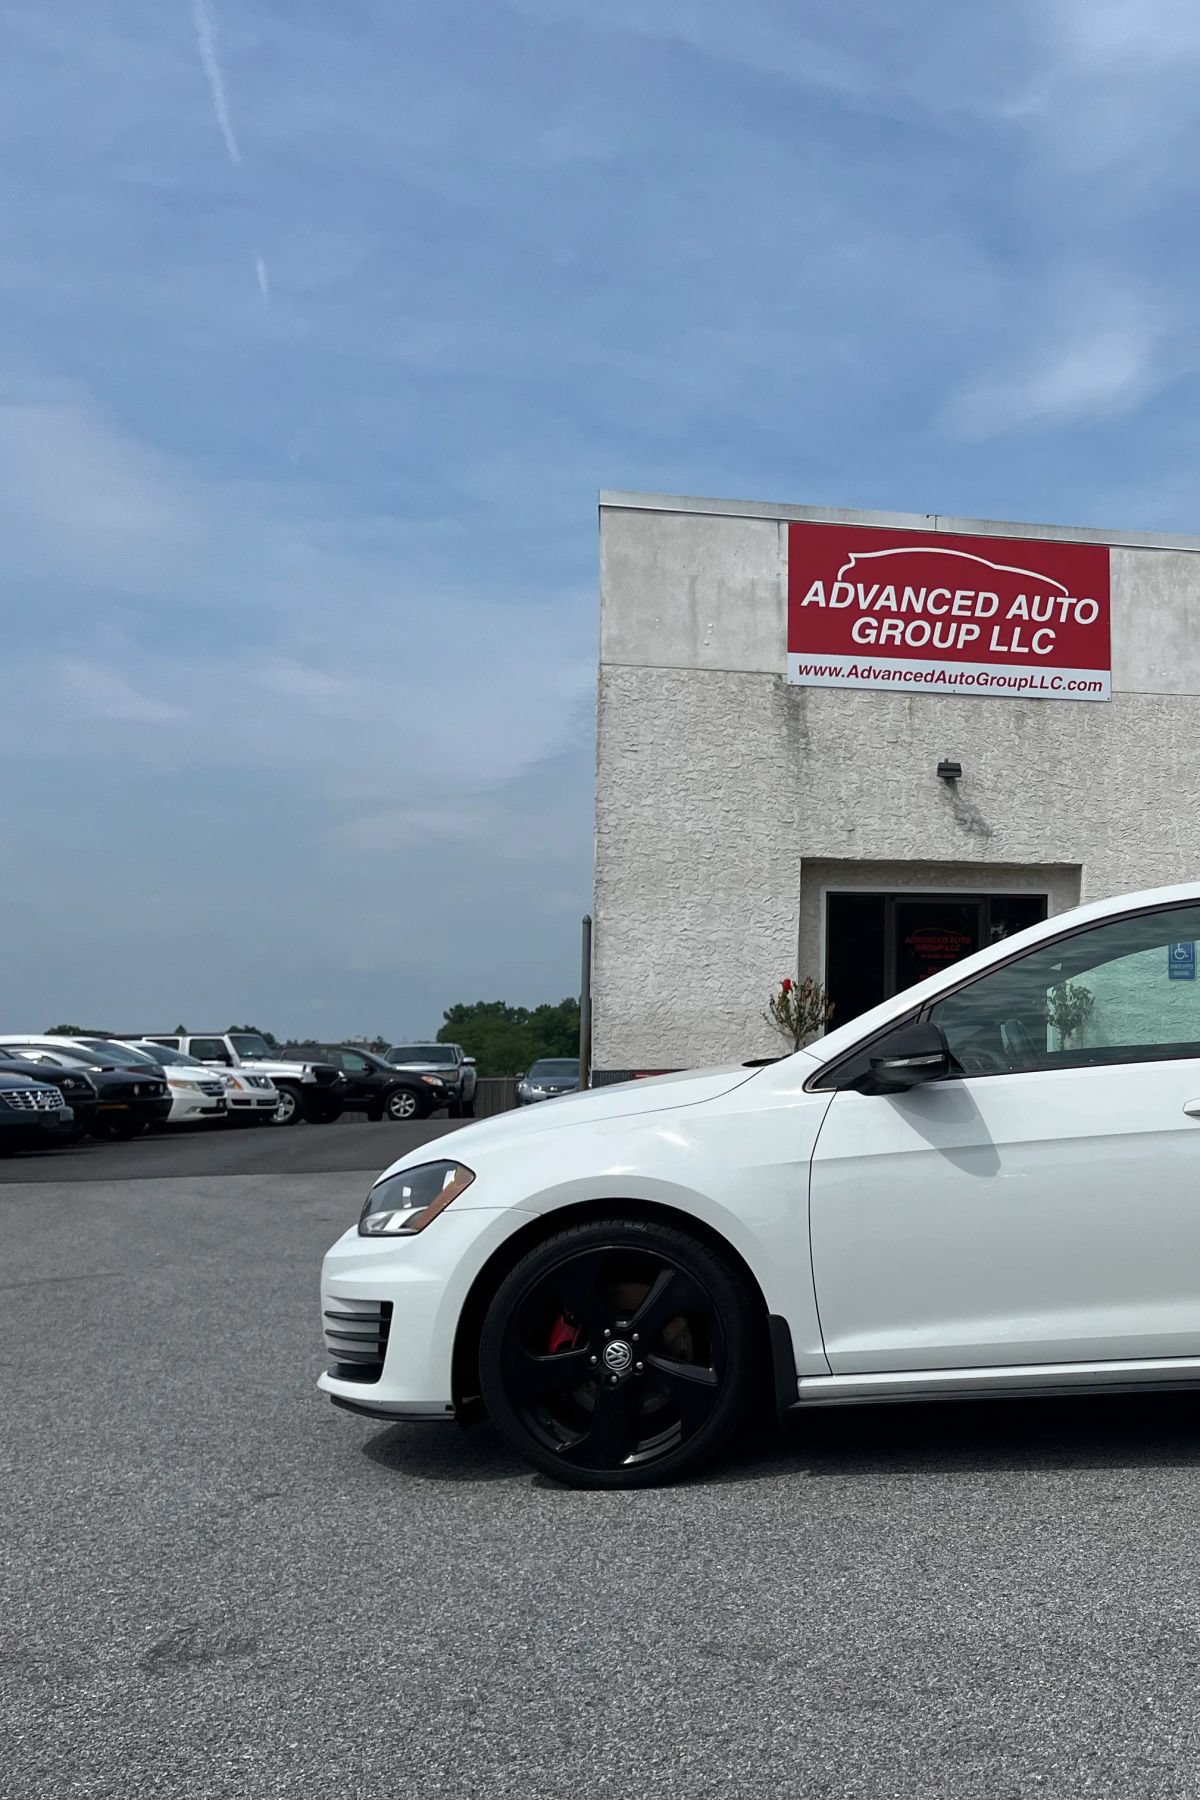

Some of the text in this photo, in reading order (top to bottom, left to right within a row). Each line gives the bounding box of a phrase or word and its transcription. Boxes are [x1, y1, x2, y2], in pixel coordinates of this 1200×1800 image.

[801, 580, 1099, 625] ADVANCED AUTO
[851, 616, 1056, 655] GROUP LLC
[798, 664, 1103, 692] www.AdvancedAutoGroupLLC.com
